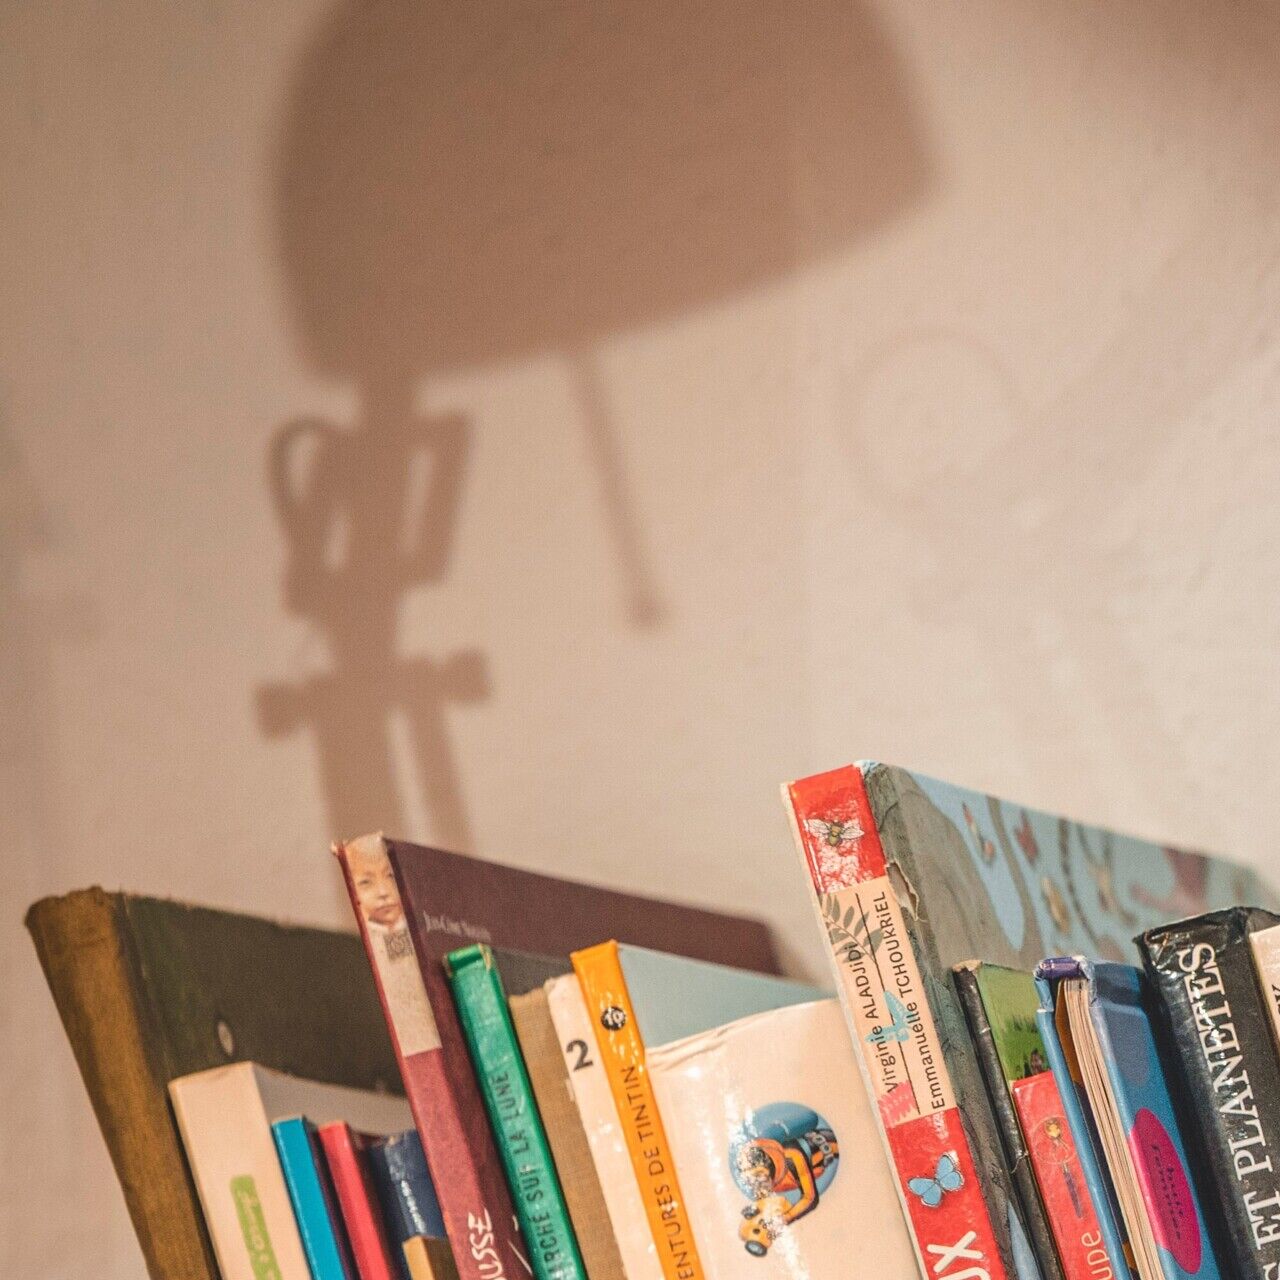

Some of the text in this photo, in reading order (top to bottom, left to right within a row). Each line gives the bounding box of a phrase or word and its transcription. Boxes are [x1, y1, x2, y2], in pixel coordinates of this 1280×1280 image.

[566, 1039, 594, 1072] 2
[870, 1025, 900, 1094] Virginie
[905, 1001, 946, 1110] Emmanuelle
[488, 1071, 530, 1156] LA LUNE
[620, 1065, 654, 1143] TINTIN
[643, 1146, 665, 1177] DE
